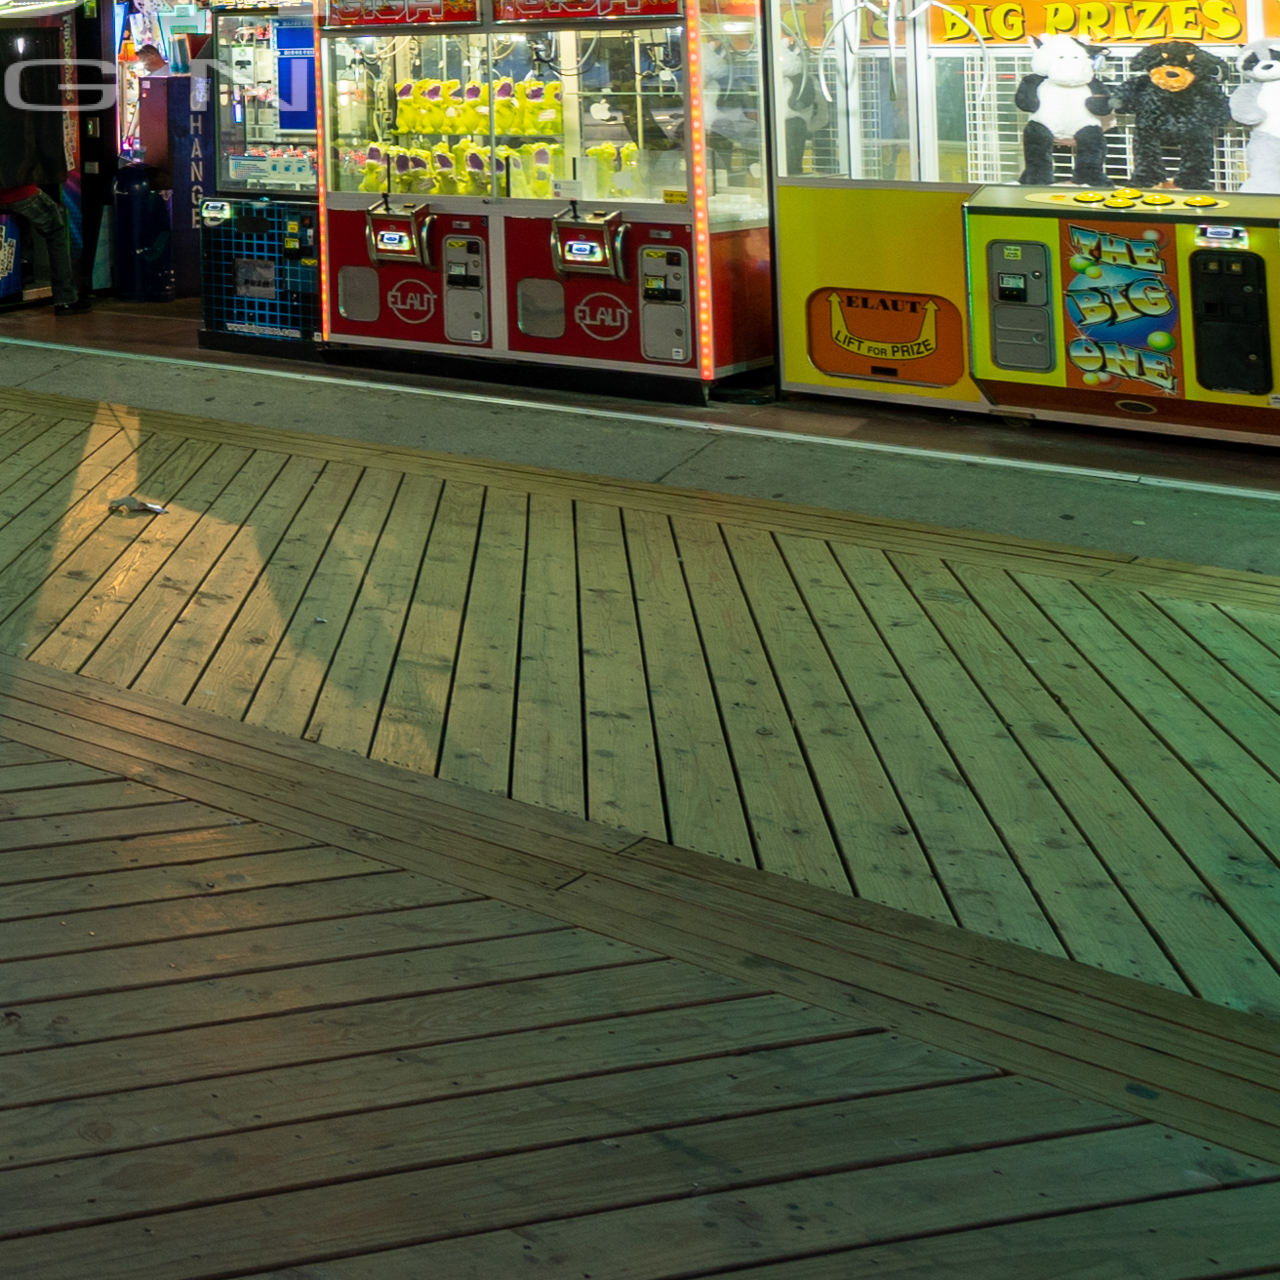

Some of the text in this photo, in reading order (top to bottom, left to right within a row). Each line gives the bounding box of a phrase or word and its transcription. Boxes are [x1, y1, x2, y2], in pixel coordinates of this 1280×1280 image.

[942, 1, 1027, 42] BIG
[190, 89, 204, 229] CHANGE
[1068, 223, 1166, 275] THE
[387, 291, 438, 311] ELAUT
[574, 305, 633, 327] ELAUT
[846, 296, 922, 314] ELAUT
[1064, 276, 1176, 329] BIG
[834, 330, 934, 357] LIFT FOR PRIZE
[1068, 336, 1178, 393] ONE
